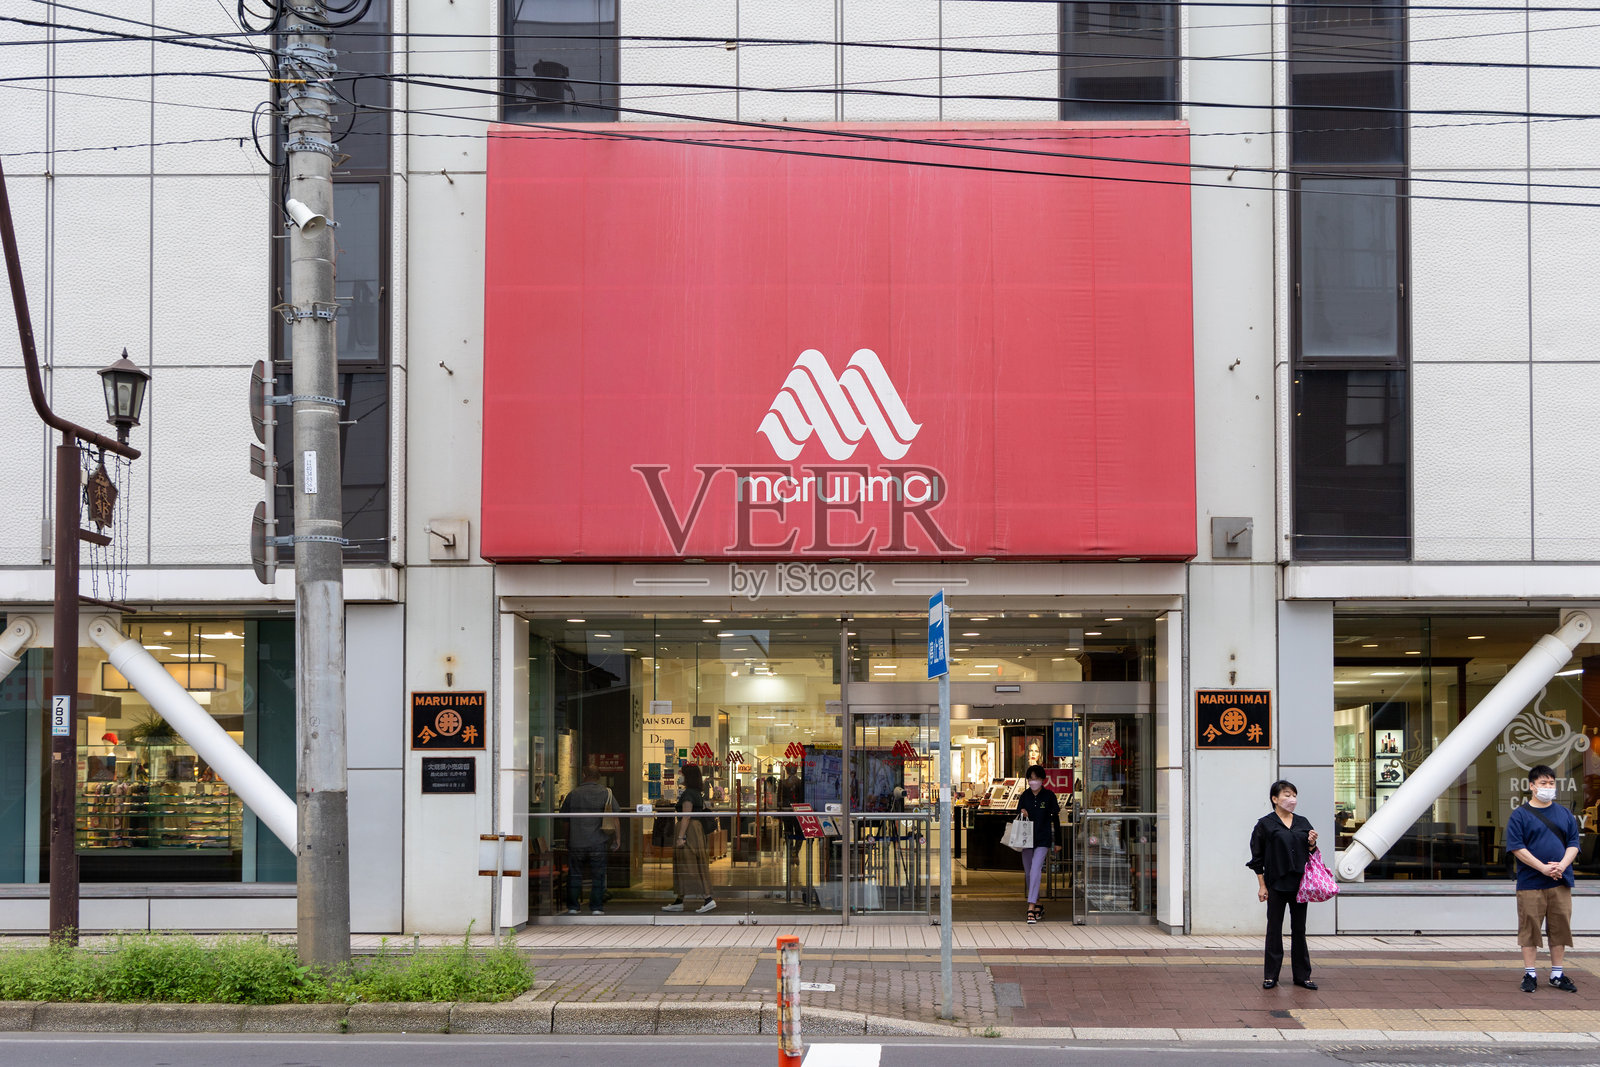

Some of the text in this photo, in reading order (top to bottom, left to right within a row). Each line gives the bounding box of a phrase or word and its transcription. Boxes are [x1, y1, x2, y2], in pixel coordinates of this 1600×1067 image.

[415, 696, 482, 706] MARUI IMAI
[1200, 694, 1267, 704] MARUI IMAI
[55, 697, 65, 726] 783
[661, 717, 685, 725] STAGE
[1043, 775, 1069, 788] 入口
